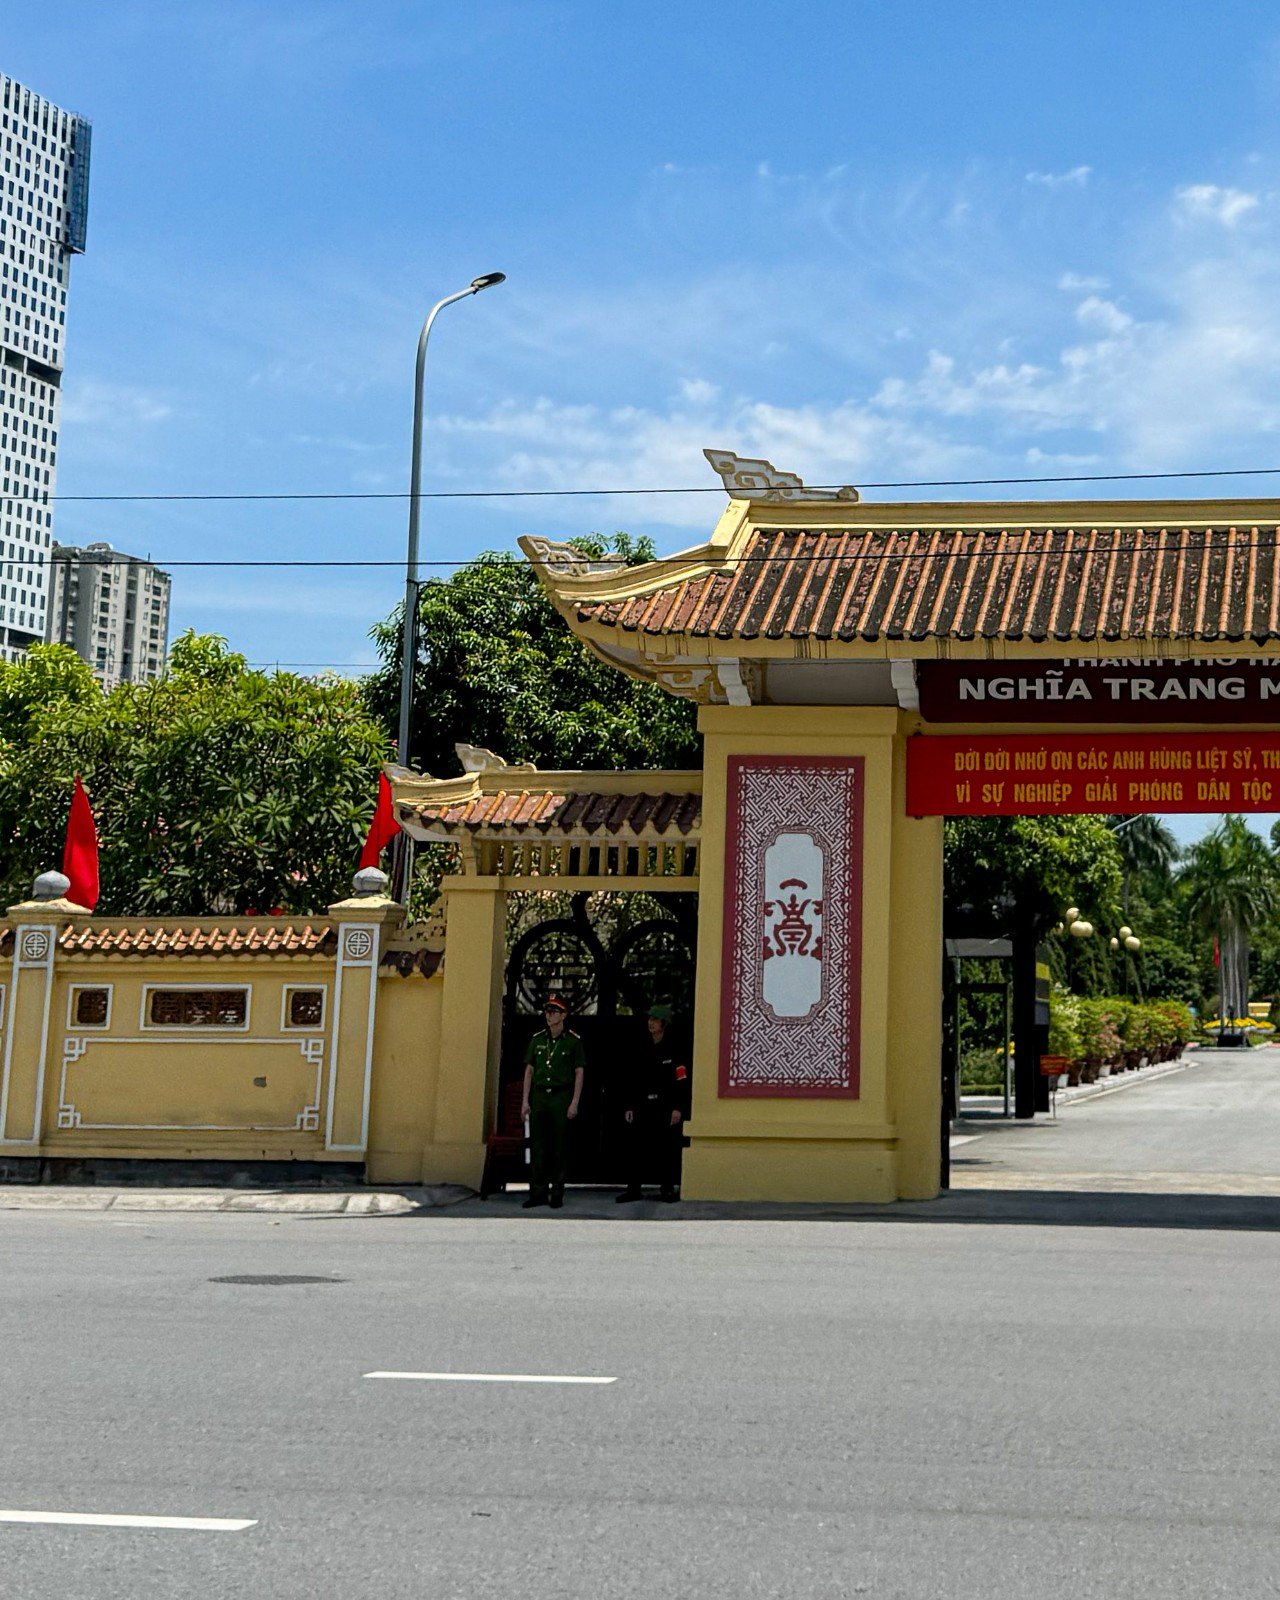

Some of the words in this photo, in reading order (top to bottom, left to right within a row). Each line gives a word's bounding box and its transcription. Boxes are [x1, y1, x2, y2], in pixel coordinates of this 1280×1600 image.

[959, 669, 1093, 700] NGHĨA
[1102, 677, 1246, 700] TRANG
[954, 747, 981, 772] ĐỜI
[984, 747, 1011, 771] ĐỜI
[1014, 746, 1048, 771] NHỚ
[1051, 750, 1073, 771] ƠN
[1077, 747, 1108, 770] CÁC
[1112, 750, 1145, 770] ANH
[1149, 746, 1192, 770] HÙNG
[1196, 746, 1228, 773] LIỆT
[955, 779, 971, 803] VÌ
[981, 781, 1005, 807] SỰ
[1013, 778, 1073, 806] NGHIỆP
[1084, 775, 1118, 802] GIẢI
[1128, 777, 1184, 802] PHÓNG
[1197, 777, 1231, 802] DÂN
[1242, 777, 1272, 805] TỘC
